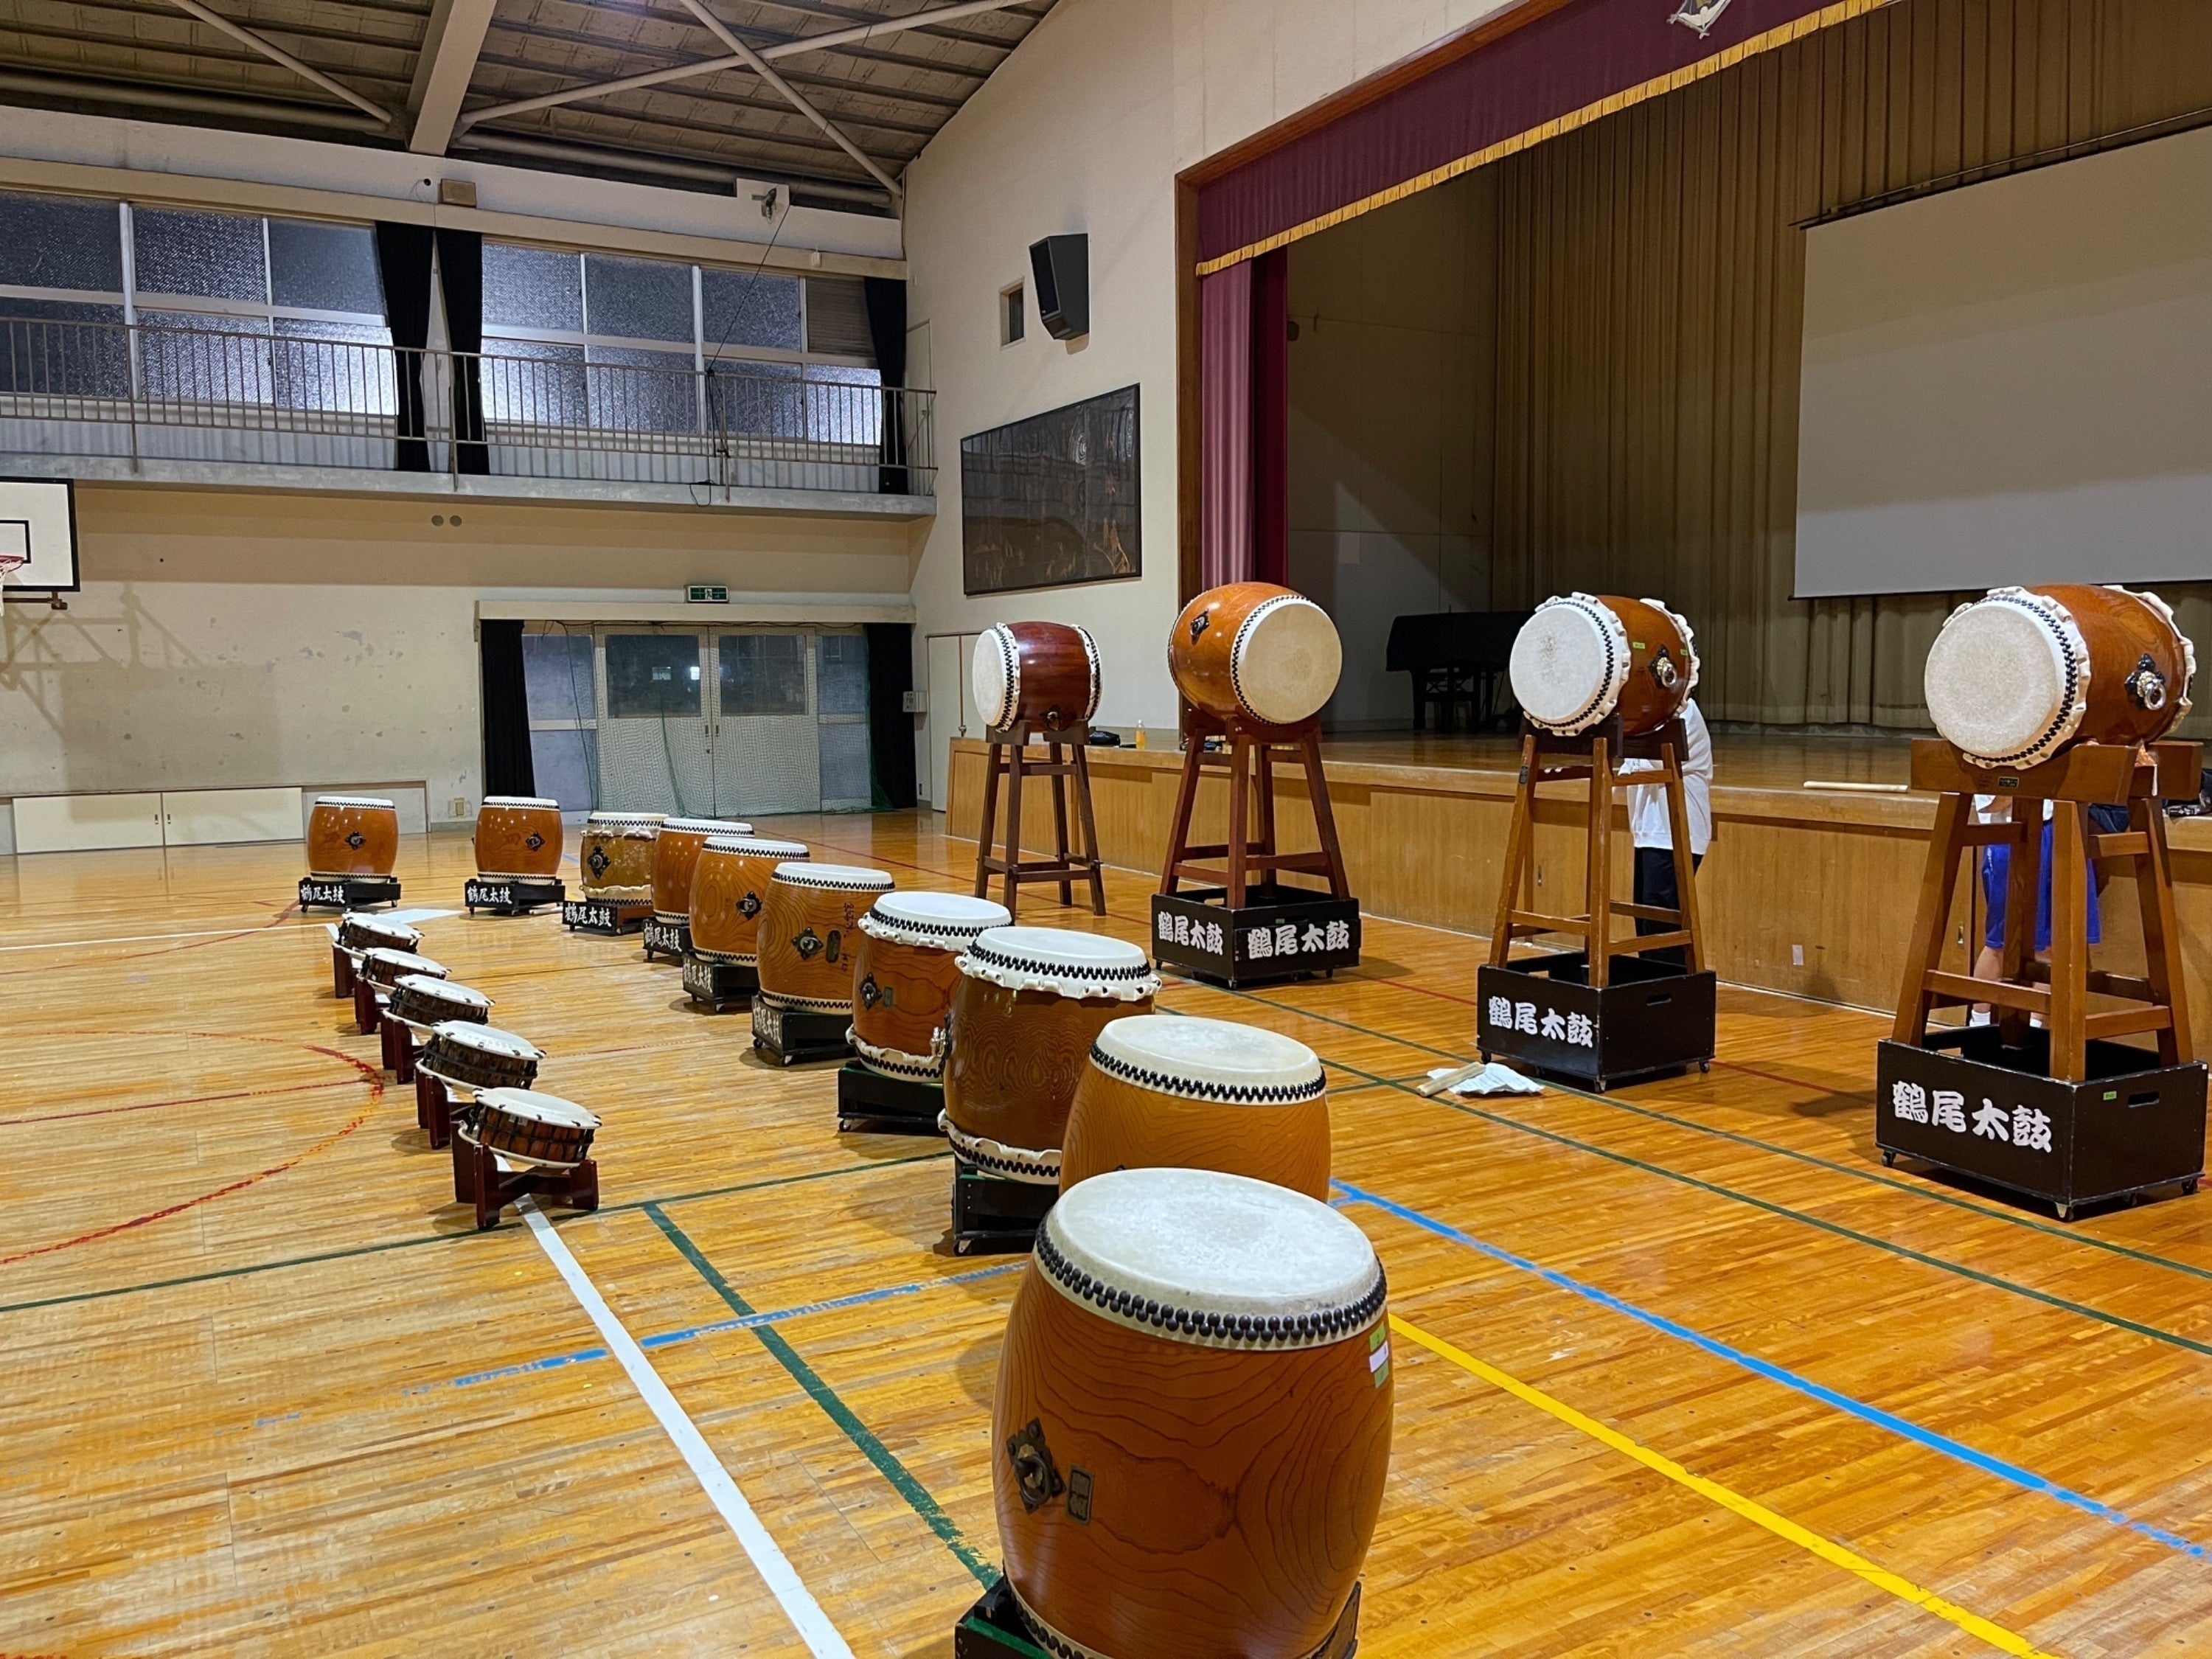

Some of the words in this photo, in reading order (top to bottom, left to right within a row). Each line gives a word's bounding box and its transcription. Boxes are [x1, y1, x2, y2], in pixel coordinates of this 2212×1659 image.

[467, 885, 512, 904] 鶴尾太鼓
[565, 902, 611, 927] 鶴尾太鼓
[1158, 911, 1223, 956] 鶴尾太鼓
[644, 922, 682, 952] 鶴尾太鼓
[1248, 920, 1349, 959] 鶴尾太鼓
[1489, 996, 1593, 1048] 鶴尾太鼓
[1893, 1081, 2052, 1152] 鶴尾太鼓
